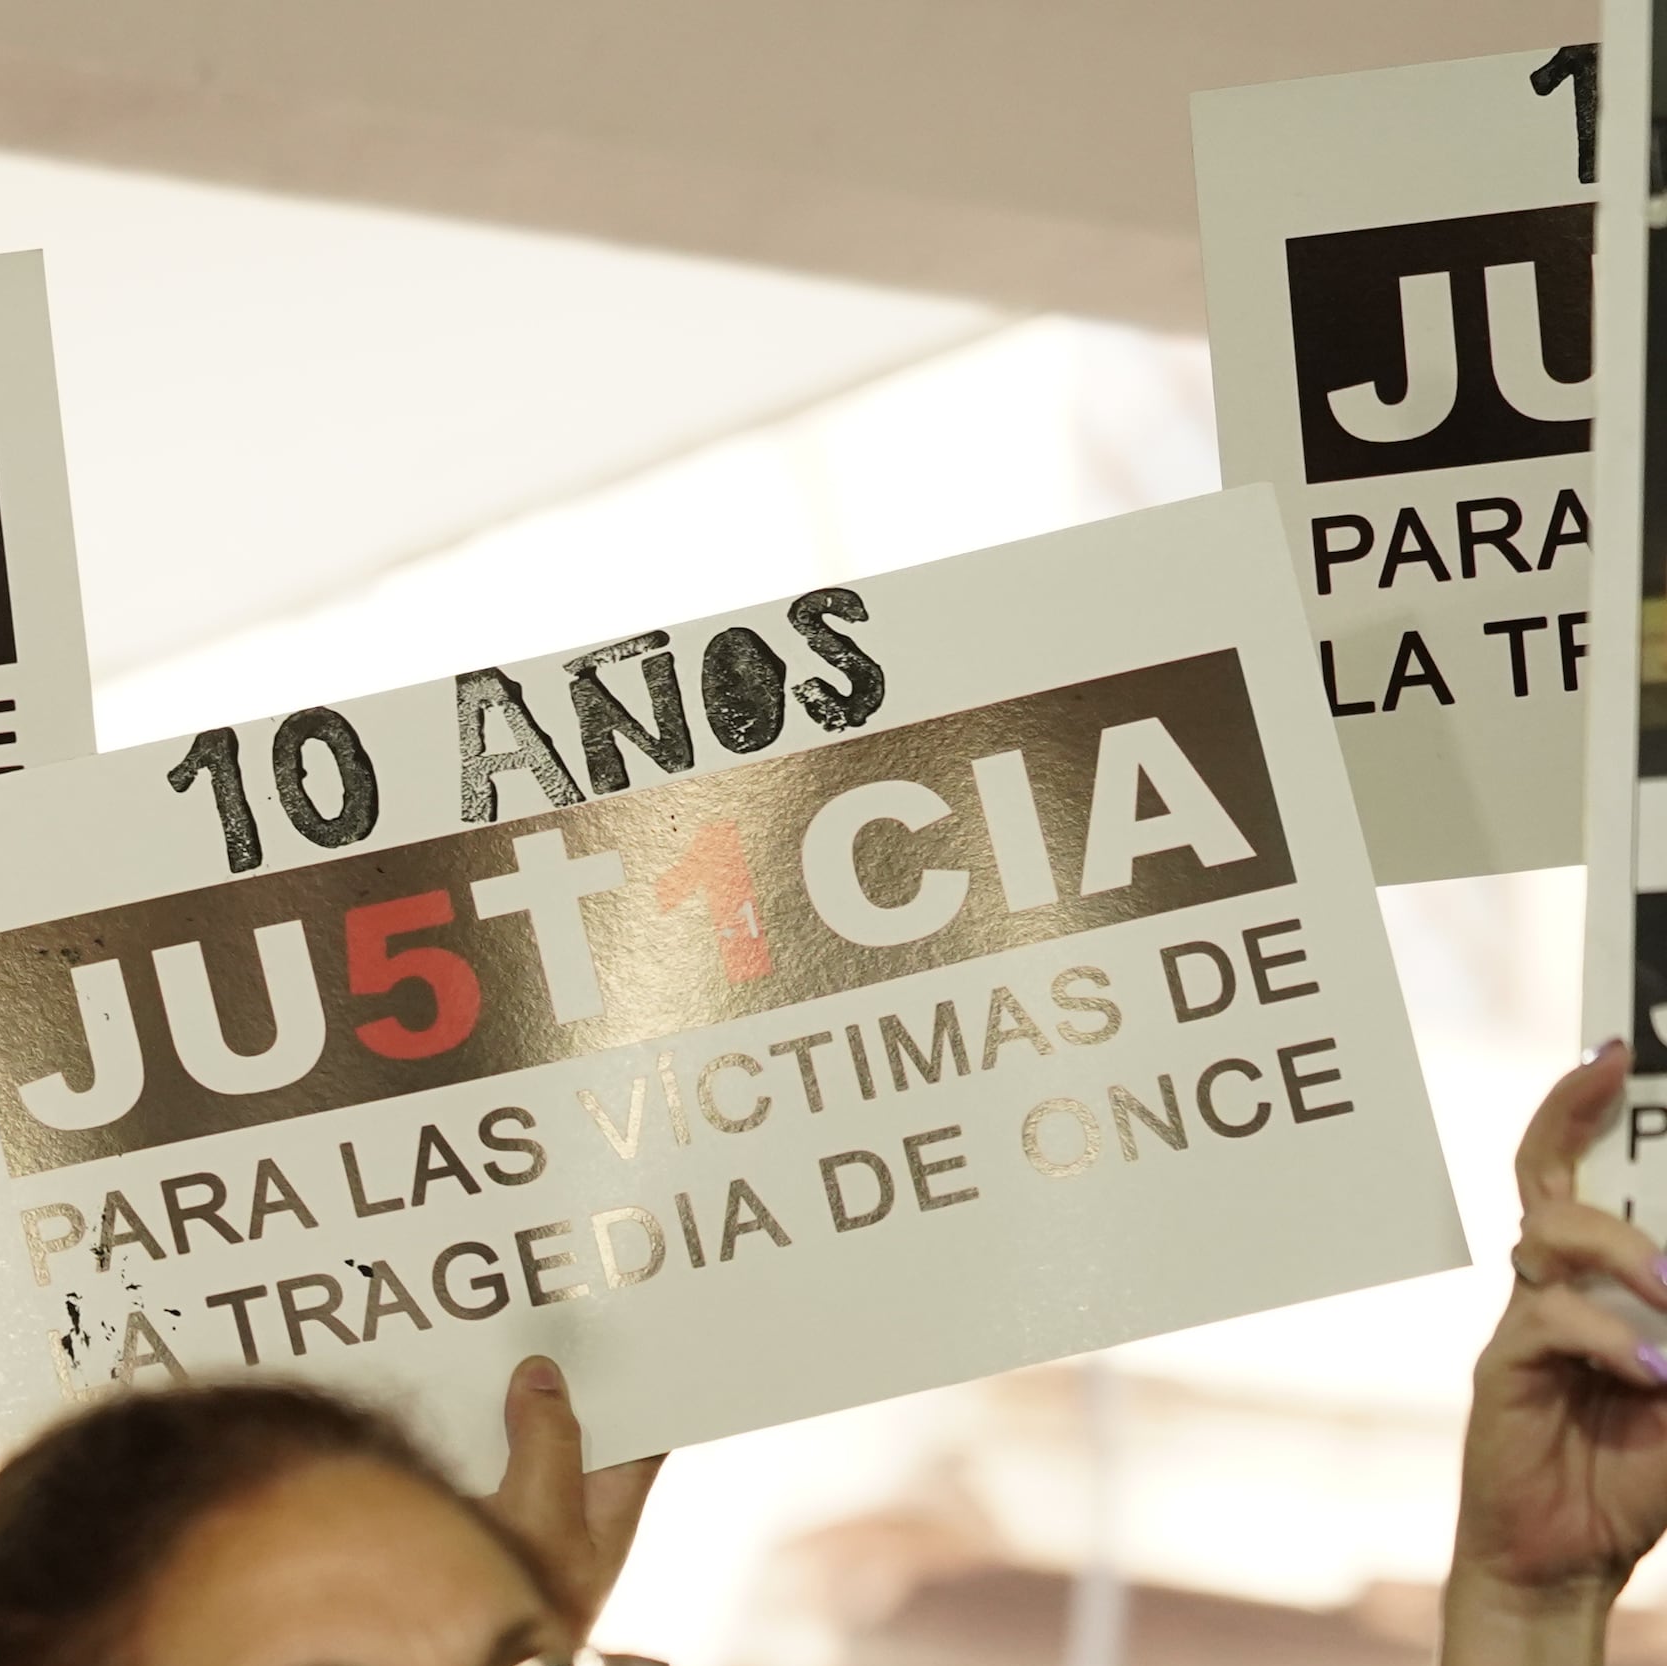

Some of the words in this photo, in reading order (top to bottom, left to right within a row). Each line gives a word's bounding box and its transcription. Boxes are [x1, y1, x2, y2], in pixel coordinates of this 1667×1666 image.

[1311, 489, 1592, 596] PARA
[1320, 630, 1456, 717] LA
[167, 706, 379, 873] 10
[456, 587, 886, 823] AÑOS
[20, 1157, 318, 1287] PARA
[340, 1107, 548, 1219] LAS
[577, 965, 1123, 1160] VÍCTIMAS
[1160, 919, 1320, 1023] DE
[48, 1310, 189, 1400] LA
[207, 1179, 791, 1366] TRAGEDIA
[819, 1125, 980, 1234] DE
[1021, 1037, 1354, 1178] ONCE
